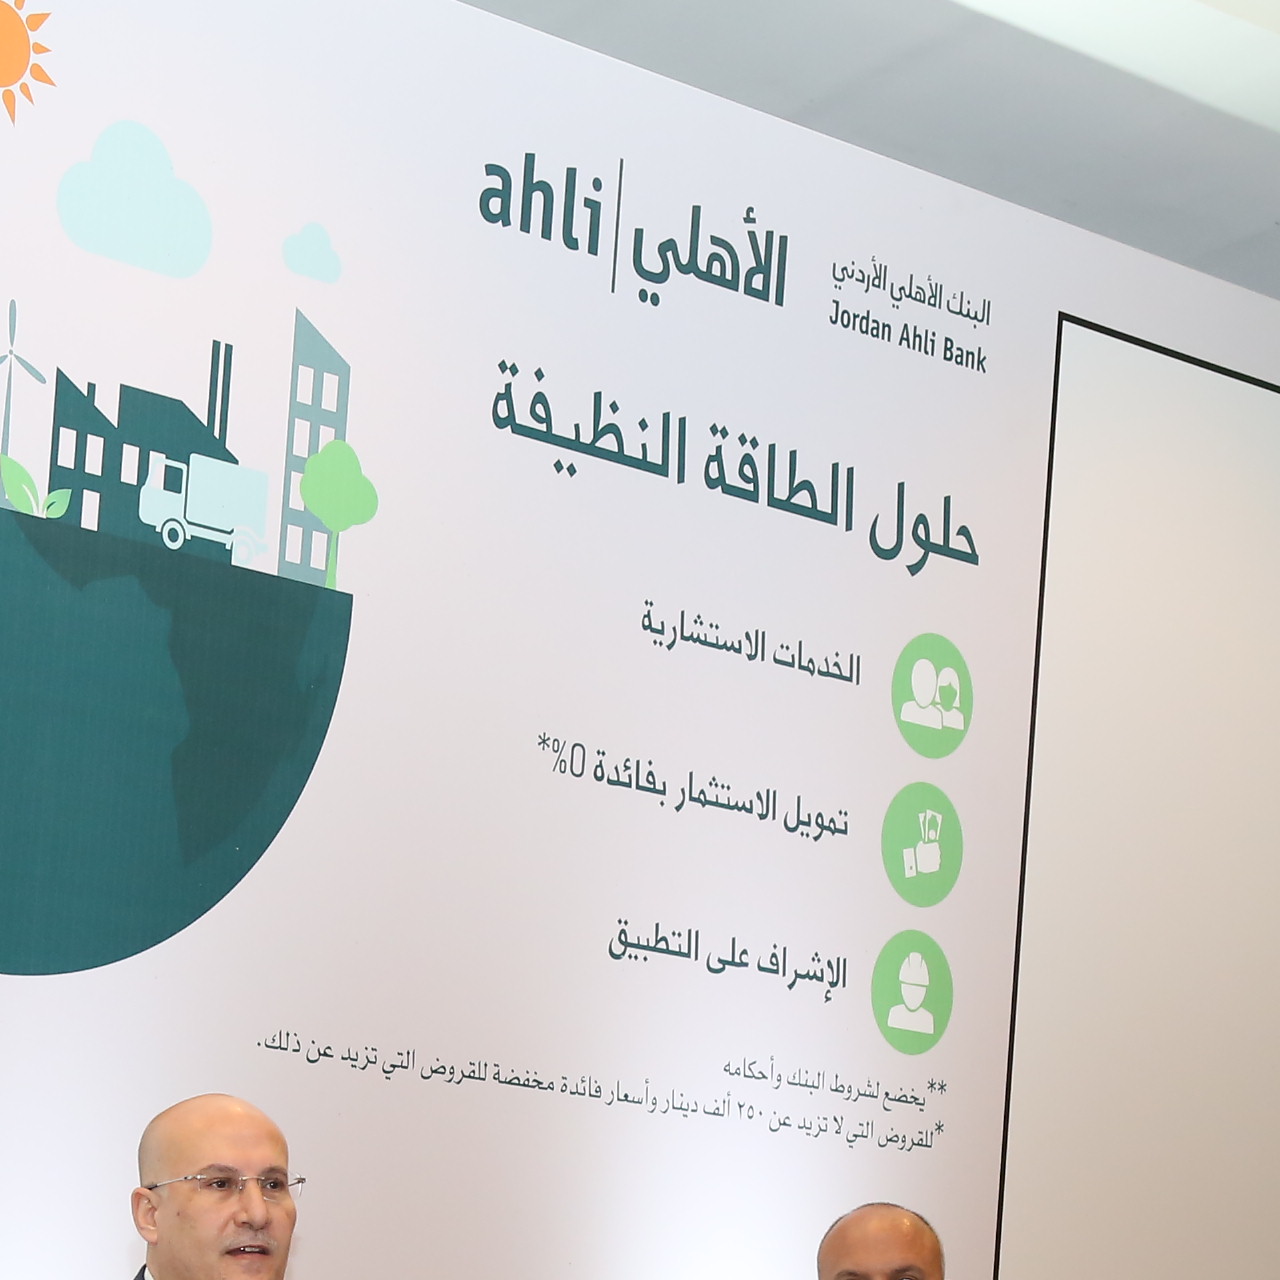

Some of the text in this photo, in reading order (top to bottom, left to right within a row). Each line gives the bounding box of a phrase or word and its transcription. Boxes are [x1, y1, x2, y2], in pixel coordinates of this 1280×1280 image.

[478, 152, 603, 257] ahli
[632, 205, 789, 308] الأهلي
[831, 254, 992, 329] البنك الأهلي الأردني
[828, 298, 988, 375] Jordan Ahli Bank
[491, 358, 980, 578] حلول الطاقة النظيفة
[641, 598, 861, 687] الخدمات الاستشارية
[592, 748, 667, 808] بفائدة
[673, 770, 777, 822] الاستثمار
[782, 794, 849, 842] تمويل
[607, 917, 847, 1004] الإشراف على التطبيق
[305, 1039, 335, 1064] عن
[340, 1045, 379, 1071] تزيد
[381, 1048, 417, 1081] التي
[419, 1057, 488, 1086] للقروض
[492, 1062, 556, 1092] مخفضة
[559, 1075, 603, 1099] فائدة
[722, 1054, 782, 1091] وأحكامه
[786, 1067, 826, 1096] البنك
[604, 1077, 658, 1114] وأسعار
[659, 1088, 699, 1119] دينار
[829, 1073, 881, 1103] لشروط
[702, 1090, 732, 1119] ألف
[768, 1109, 793, 1133] عن
[797, 1114, 829, 1139] تزيد
[832, 1114, 845, 1136] لا
[845, 1119, 875, 1150] التي
